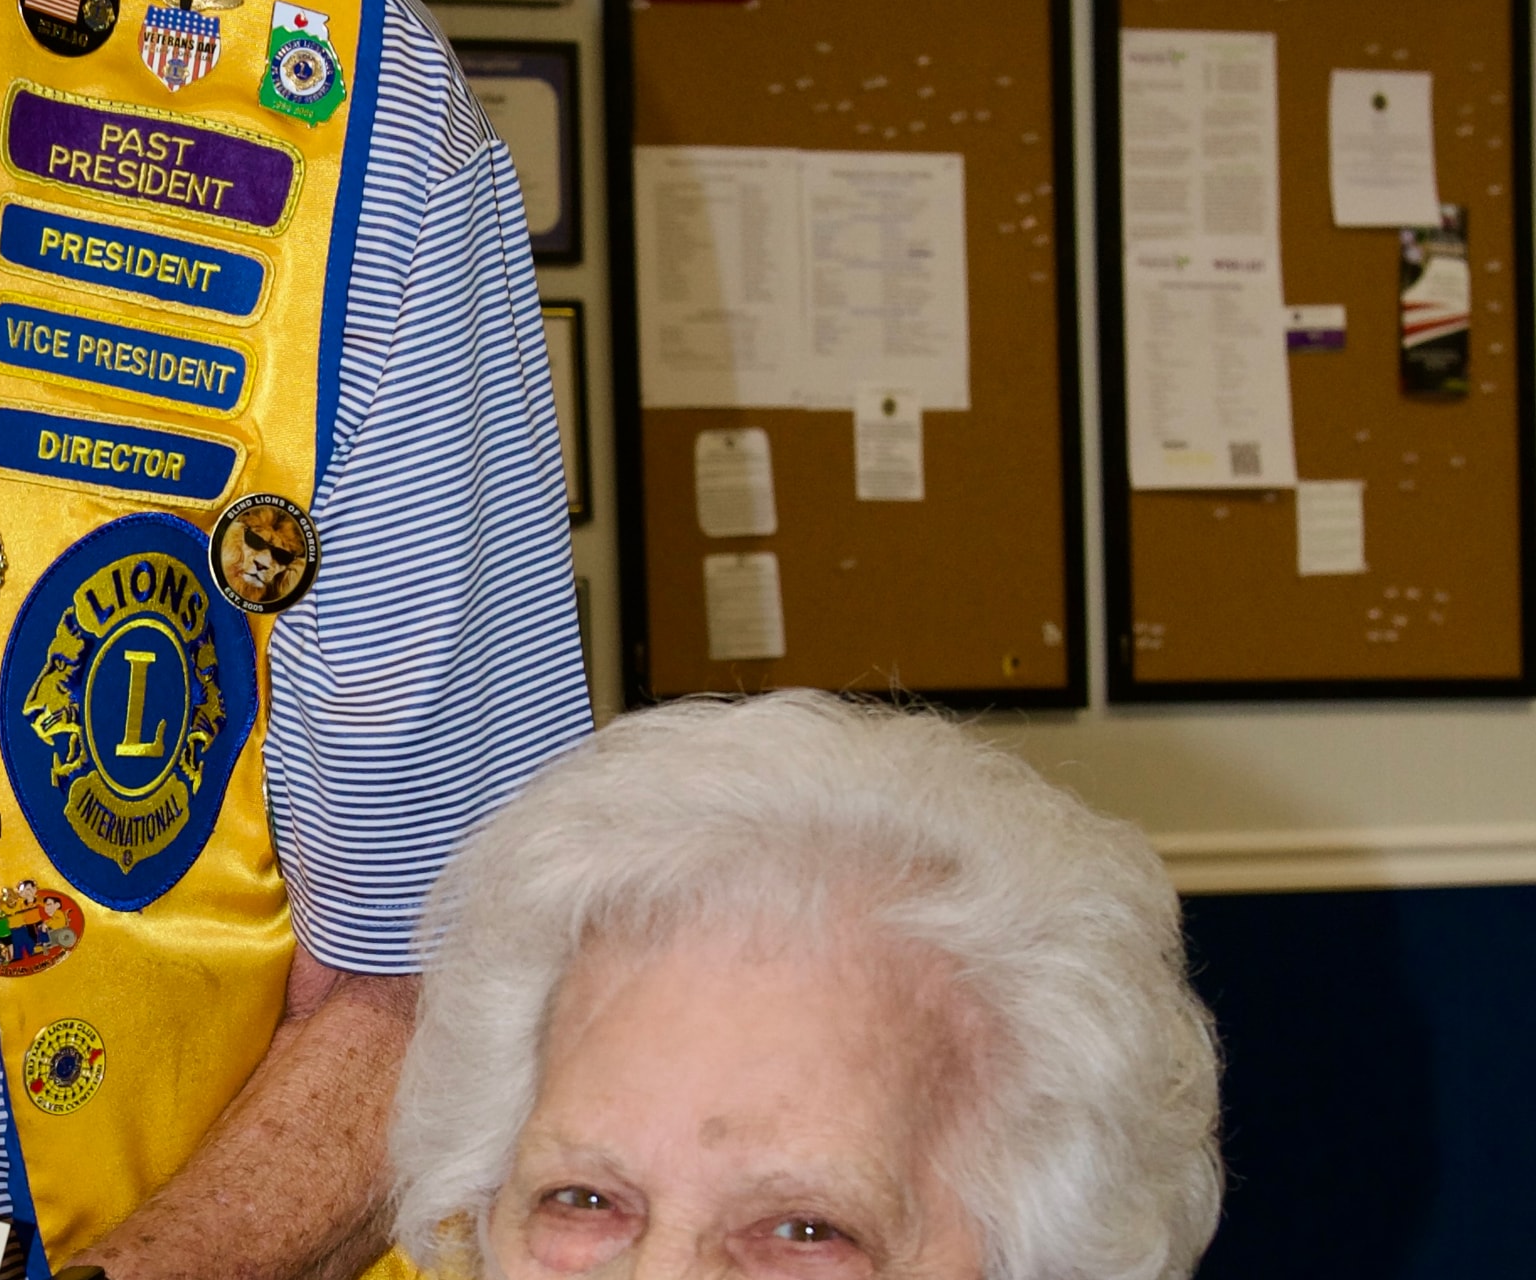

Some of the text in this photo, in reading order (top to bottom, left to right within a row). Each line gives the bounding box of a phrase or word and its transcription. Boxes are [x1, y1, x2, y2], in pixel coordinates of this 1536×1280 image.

[50, 29, 88, 48] FLAG
[143, 31, 217, 55] VETERANS DAY
[99, 123, 195, 166] PAST
[47, 144, 234, 210] PRESIDENT
[39, 227, 222, 293] PRESIDENT
[7, 316, 236, 395] VICE PRESIDENT
[37, 429, 187, 482] DIRECTOR
[226, 495, 317, 563] BLIND LIONS OF GEORGIA
[85, 558, 205, 640] LIONS
[224, 586, 241, 604] EST.
[115, 650, 168, 758] L
[75, 788, 184, 848] INTERNATIONAL
[47, 1021, 75, 1036] LIONS
[76, 1023, 97, 1042] CLUB
